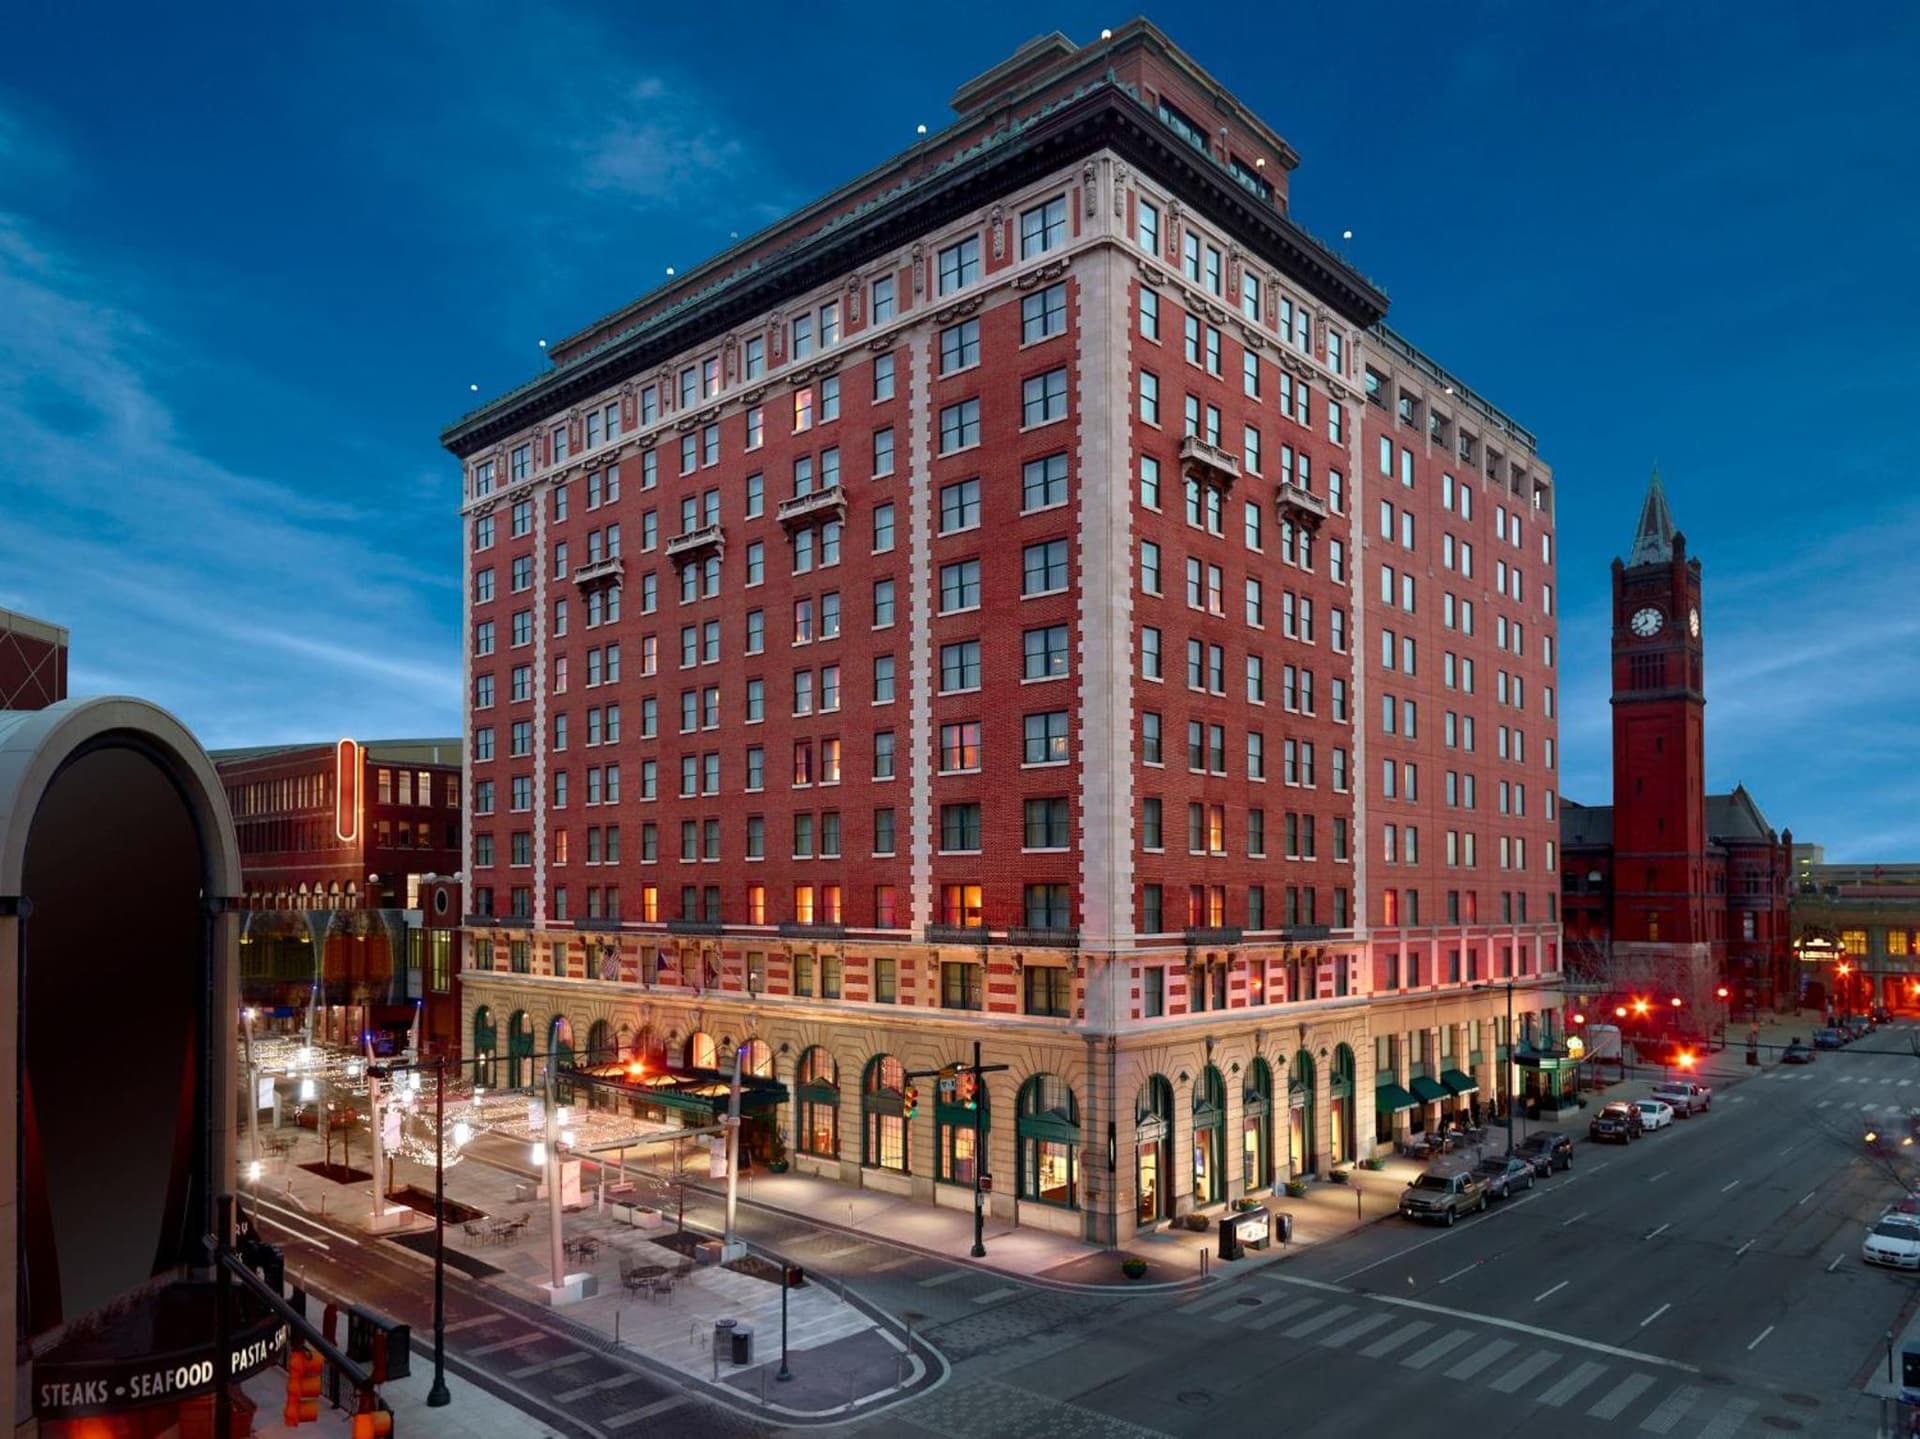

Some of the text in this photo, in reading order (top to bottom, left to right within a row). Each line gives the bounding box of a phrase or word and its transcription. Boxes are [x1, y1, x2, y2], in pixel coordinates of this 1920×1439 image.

[41, 1340, 267, 1406] STEAKS SEAFOOD PASTA
